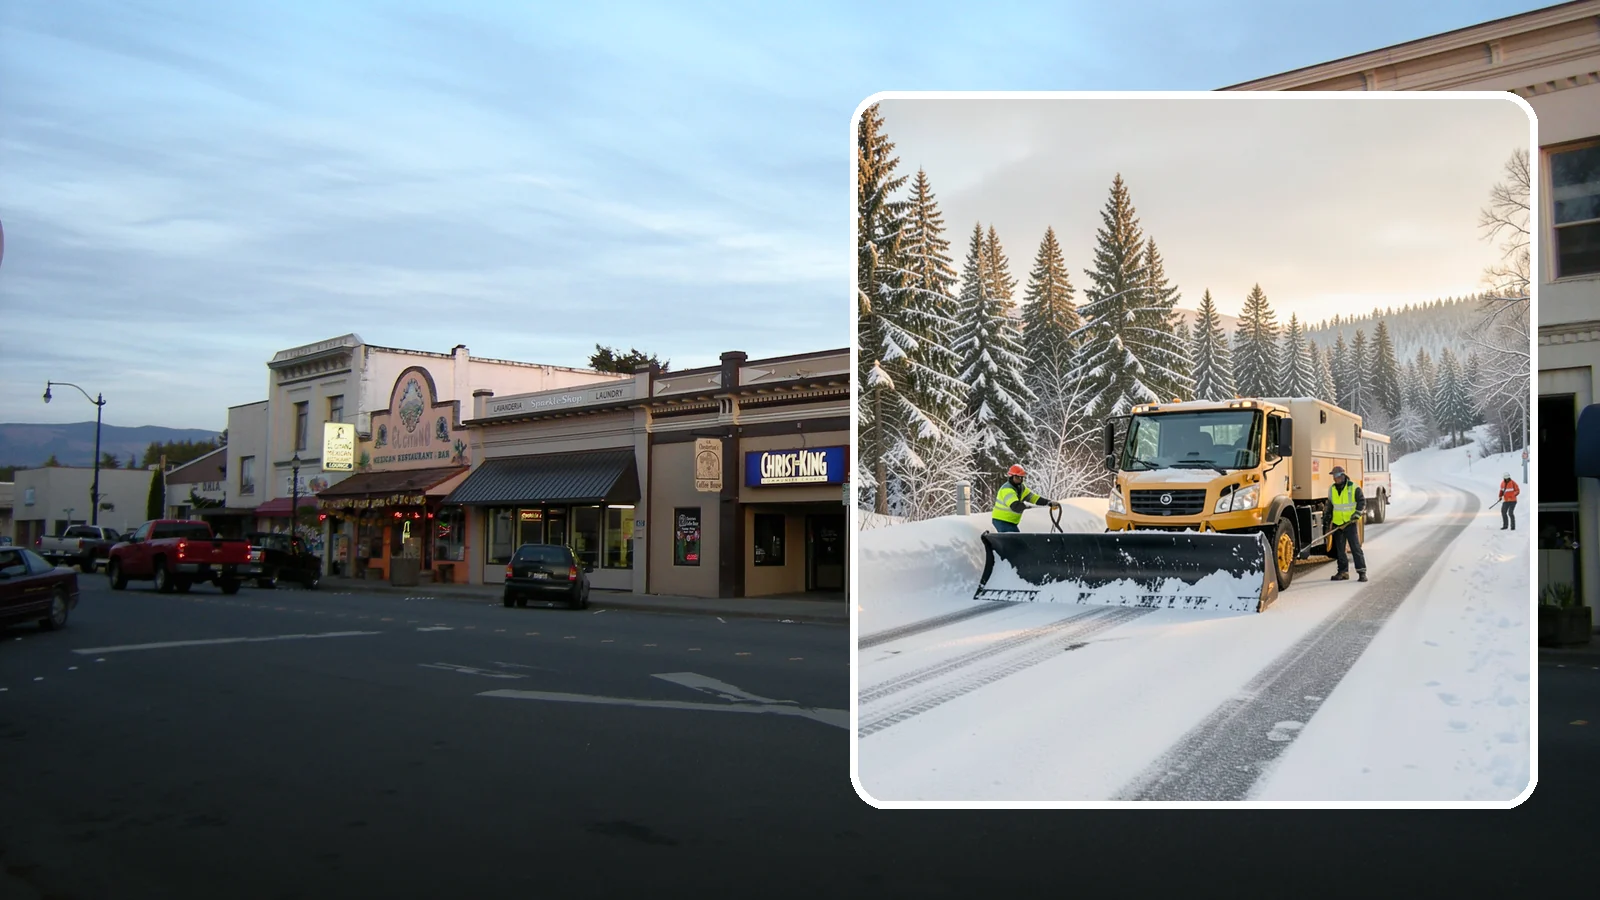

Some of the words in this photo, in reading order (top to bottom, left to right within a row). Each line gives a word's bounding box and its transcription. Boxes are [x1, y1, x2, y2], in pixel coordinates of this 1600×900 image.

[531, 398, 560, 409] Sparkle
[561, 394, 582, 405] Shop
[596, 389, 623, 400] LAUNDRY
[493, 402, 522, 412] LAVANDERIA
[374, 455, 396, 464] MEXICAN
[398, 451, 433, 462] RESTAURANT
[438, 450, 450, 459] BAR
[761, 452, 797, 478] CHRIST
[799, 450, 827, 476] KING
